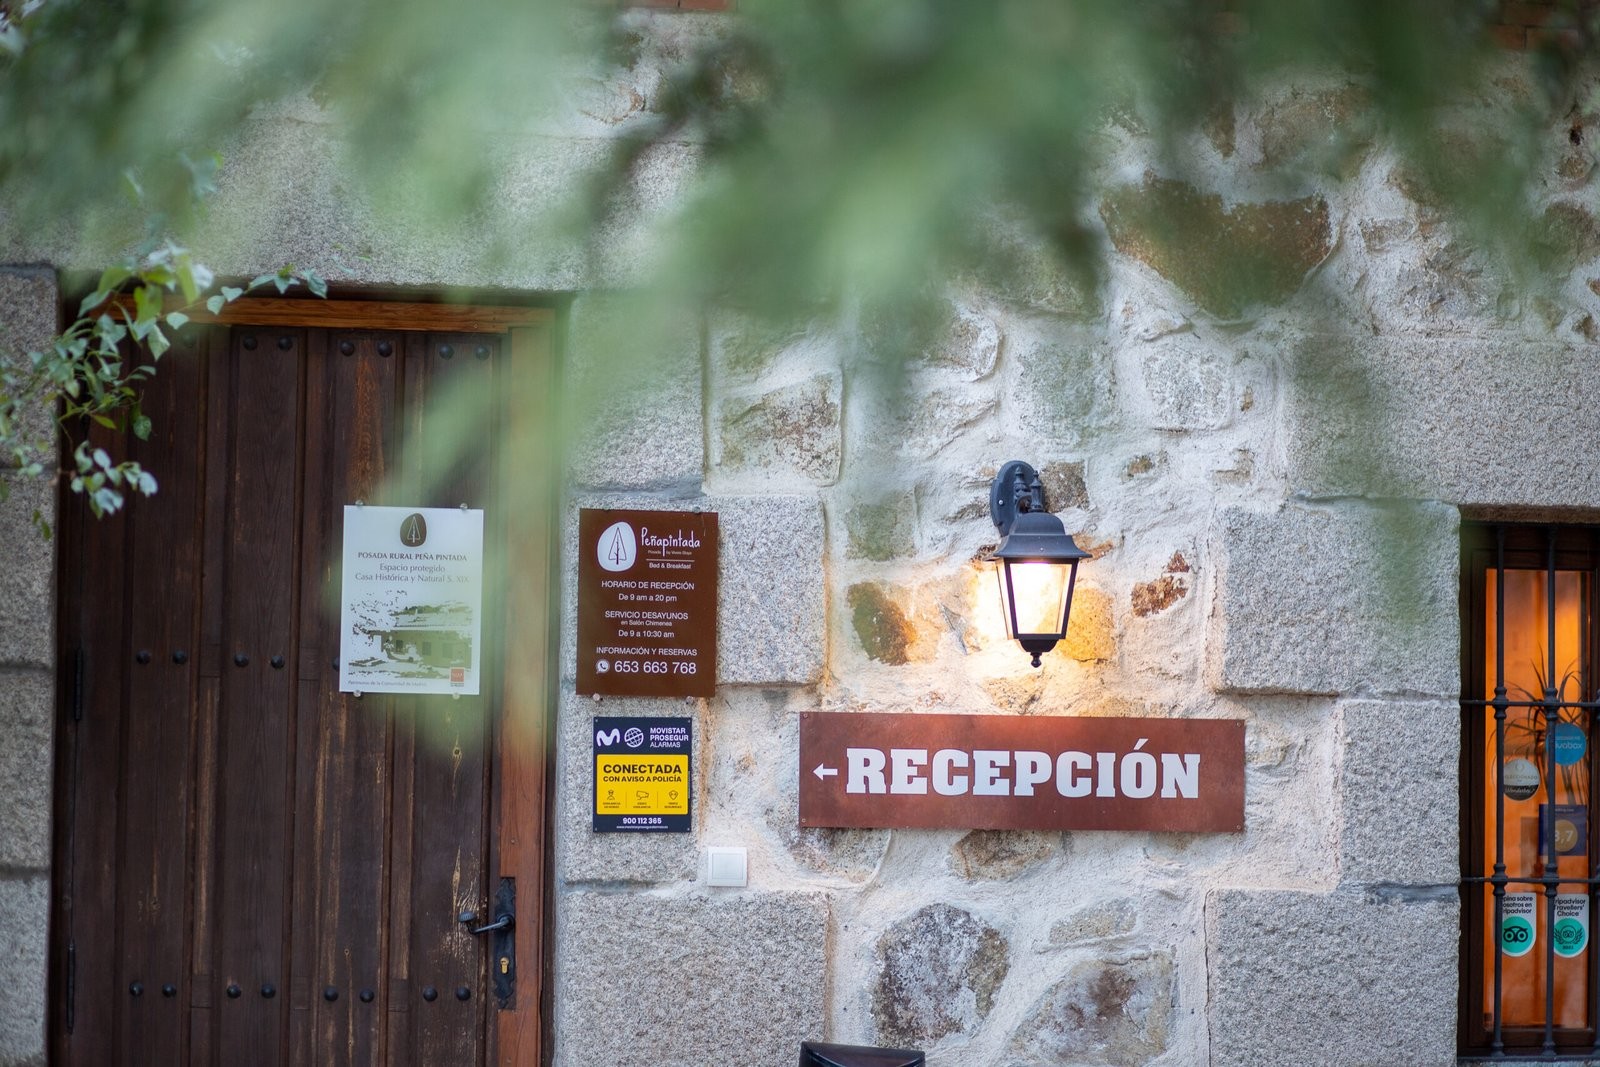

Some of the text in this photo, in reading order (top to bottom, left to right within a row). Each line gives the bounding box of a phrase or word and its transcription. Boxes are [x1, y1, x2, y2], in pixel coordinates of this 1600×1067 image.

[641, 526, 700, 556] Peñapintada
[415, 552, 434, 560] PEÑA
[380, 563, 445, 573] Espacio protegido
[375, 573, 409, 581] Histórica
[650, 581, 694, 590] RECEPCIÓN
[596, 646, 650, 655] INFORMACIÓN
[659, 648, 698, 656] RESERVAS
[614, 661, 697, 674] 653 663 768
[603, 764, 682, 774] CONECTADA
[846, 738, 1200, 799] RECEPCIÓN
